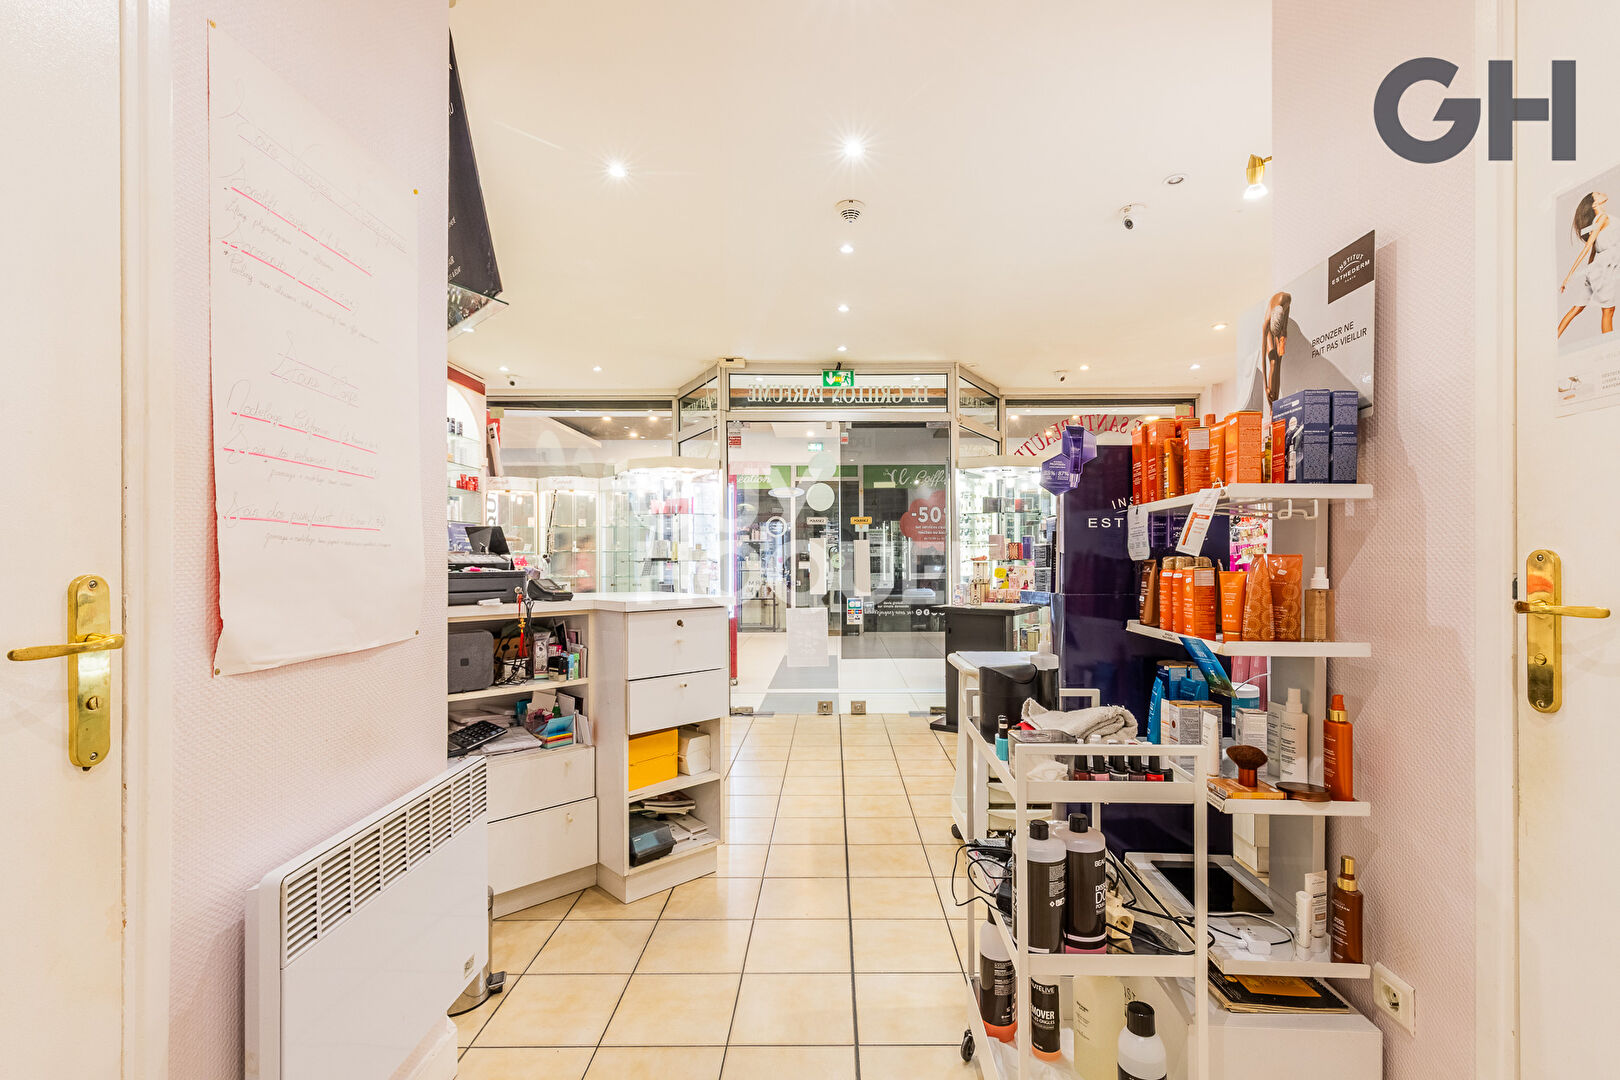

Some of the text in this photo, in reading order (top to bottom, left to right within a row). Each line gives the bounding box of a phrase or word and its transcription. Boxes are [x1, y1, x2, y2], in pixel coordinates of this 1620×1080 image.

[1331, 259, 1371, 285] ESTHEDERM
[1337, 253, 1364, 273] INSTITUT
[1311, 321, 1355, 348] BRONZER NE
[1311, 327, 1368, 359] FAIT PAS VIEILLIR
[911, 506, 946, 523] -50
[1031, 1003, 1055, 1020] MOVER
